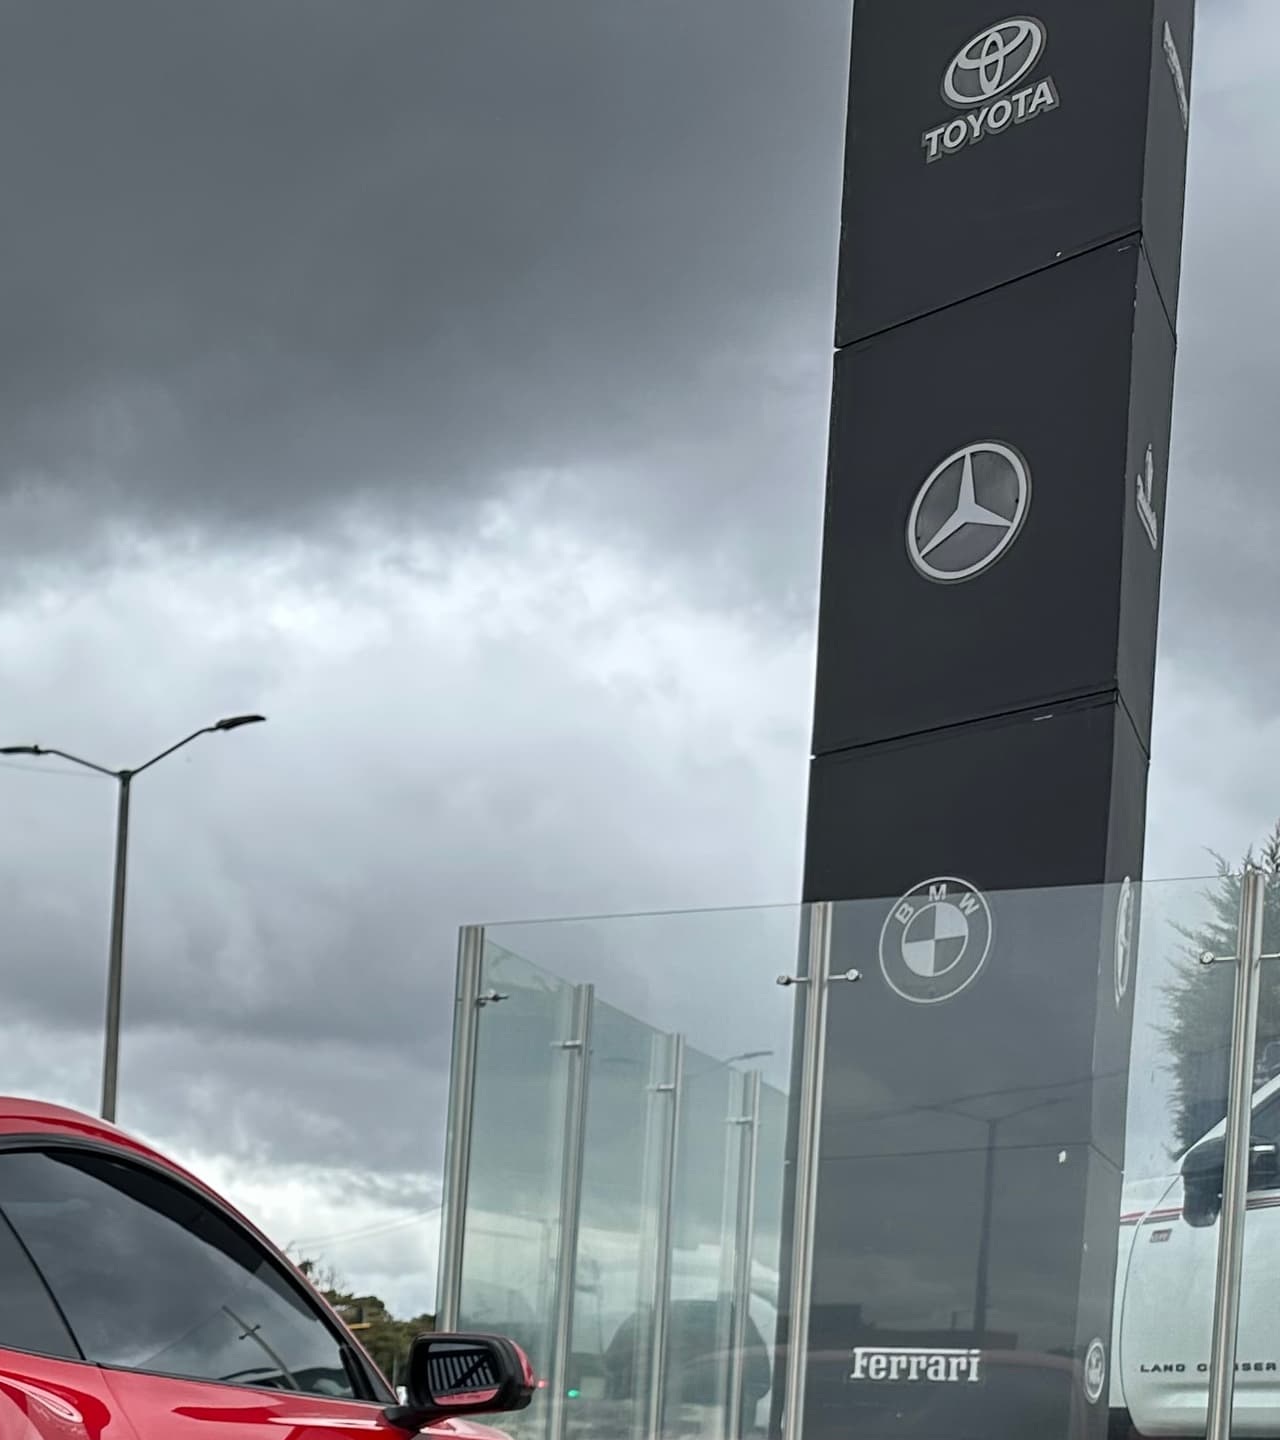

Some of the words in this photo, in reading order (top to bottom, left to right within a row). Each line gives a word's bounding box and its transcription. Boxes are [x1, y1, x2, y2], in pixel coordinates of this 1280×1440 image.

[924, 80, 1055, 157] TOYOTA
[895, 883, 980, 925] BMW
[850, 1347, 981, 1382] Ferrari
[1140, 1363, 1186, 1373] LAND
[1196, 1362, 1277, 1373] CISER
